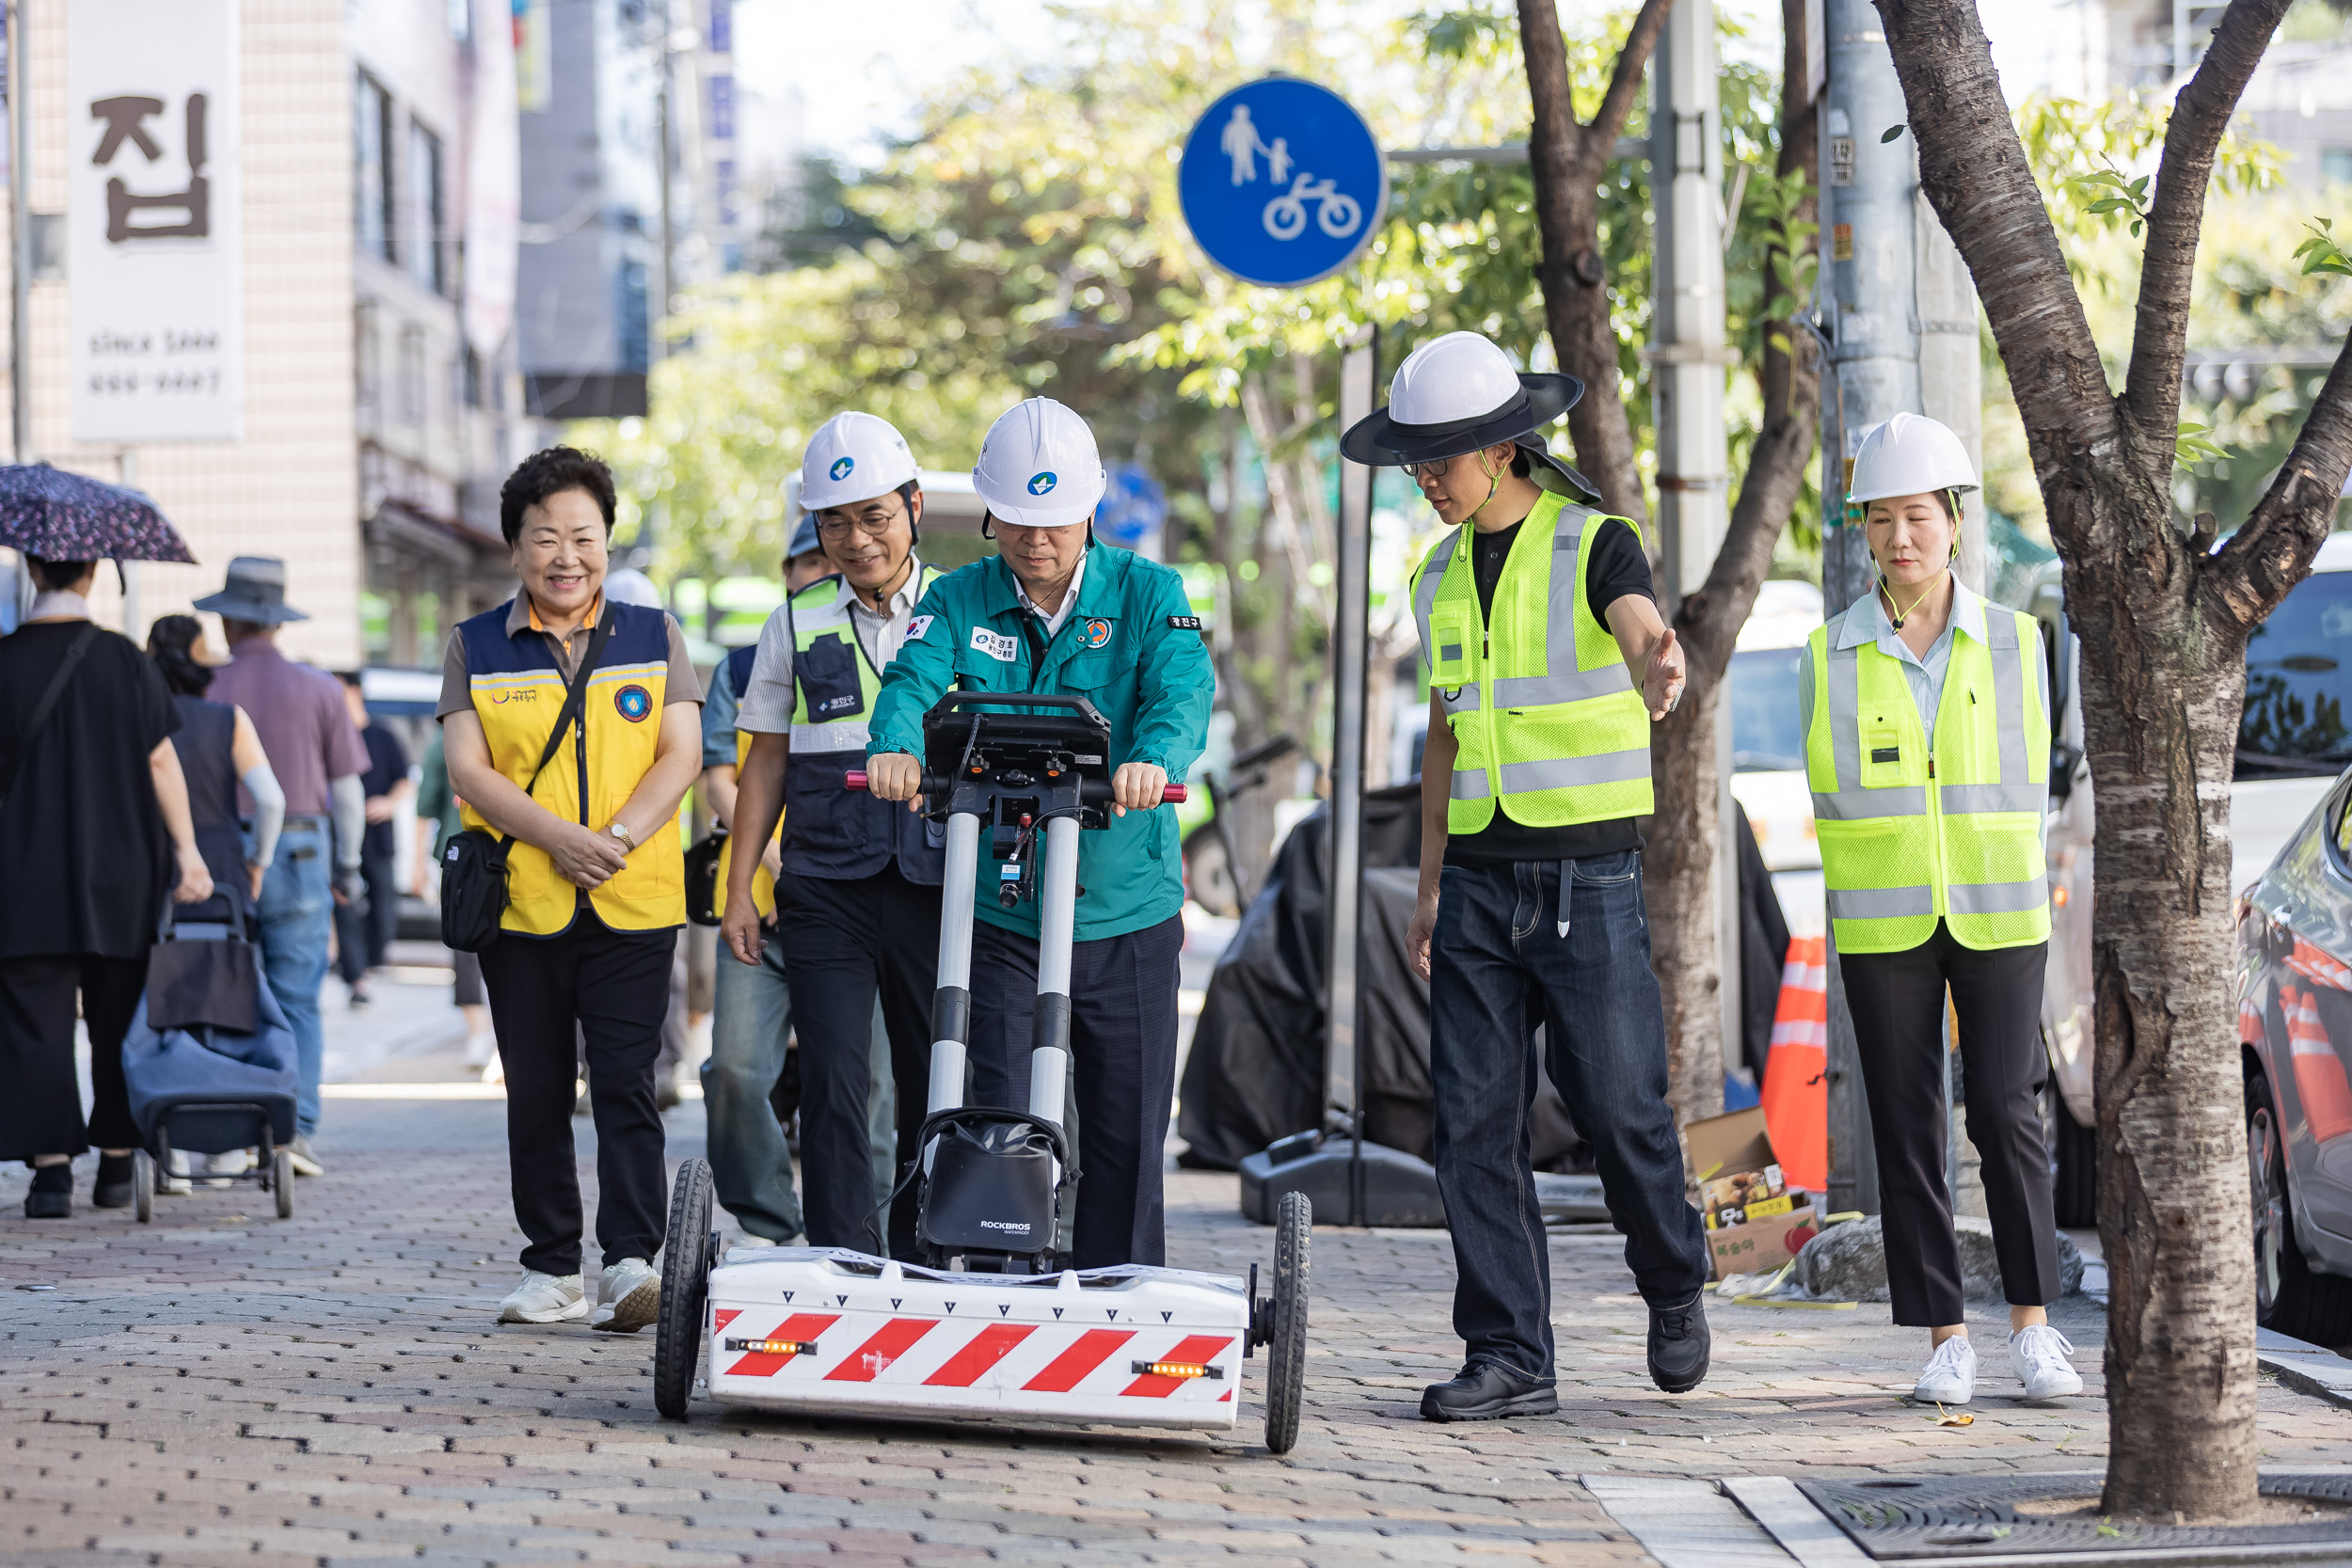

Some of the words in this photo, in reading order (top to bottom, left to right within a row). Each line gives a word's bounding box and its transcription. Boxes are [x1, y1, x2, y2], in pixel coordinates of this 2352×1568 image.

[89, 92, 209, 243] 집
[1172, 617, 1198, 626] 광진구
[830, 695, 854, 705] 광진구
[980, 1220, 1031, 1230] ROCKBROS
